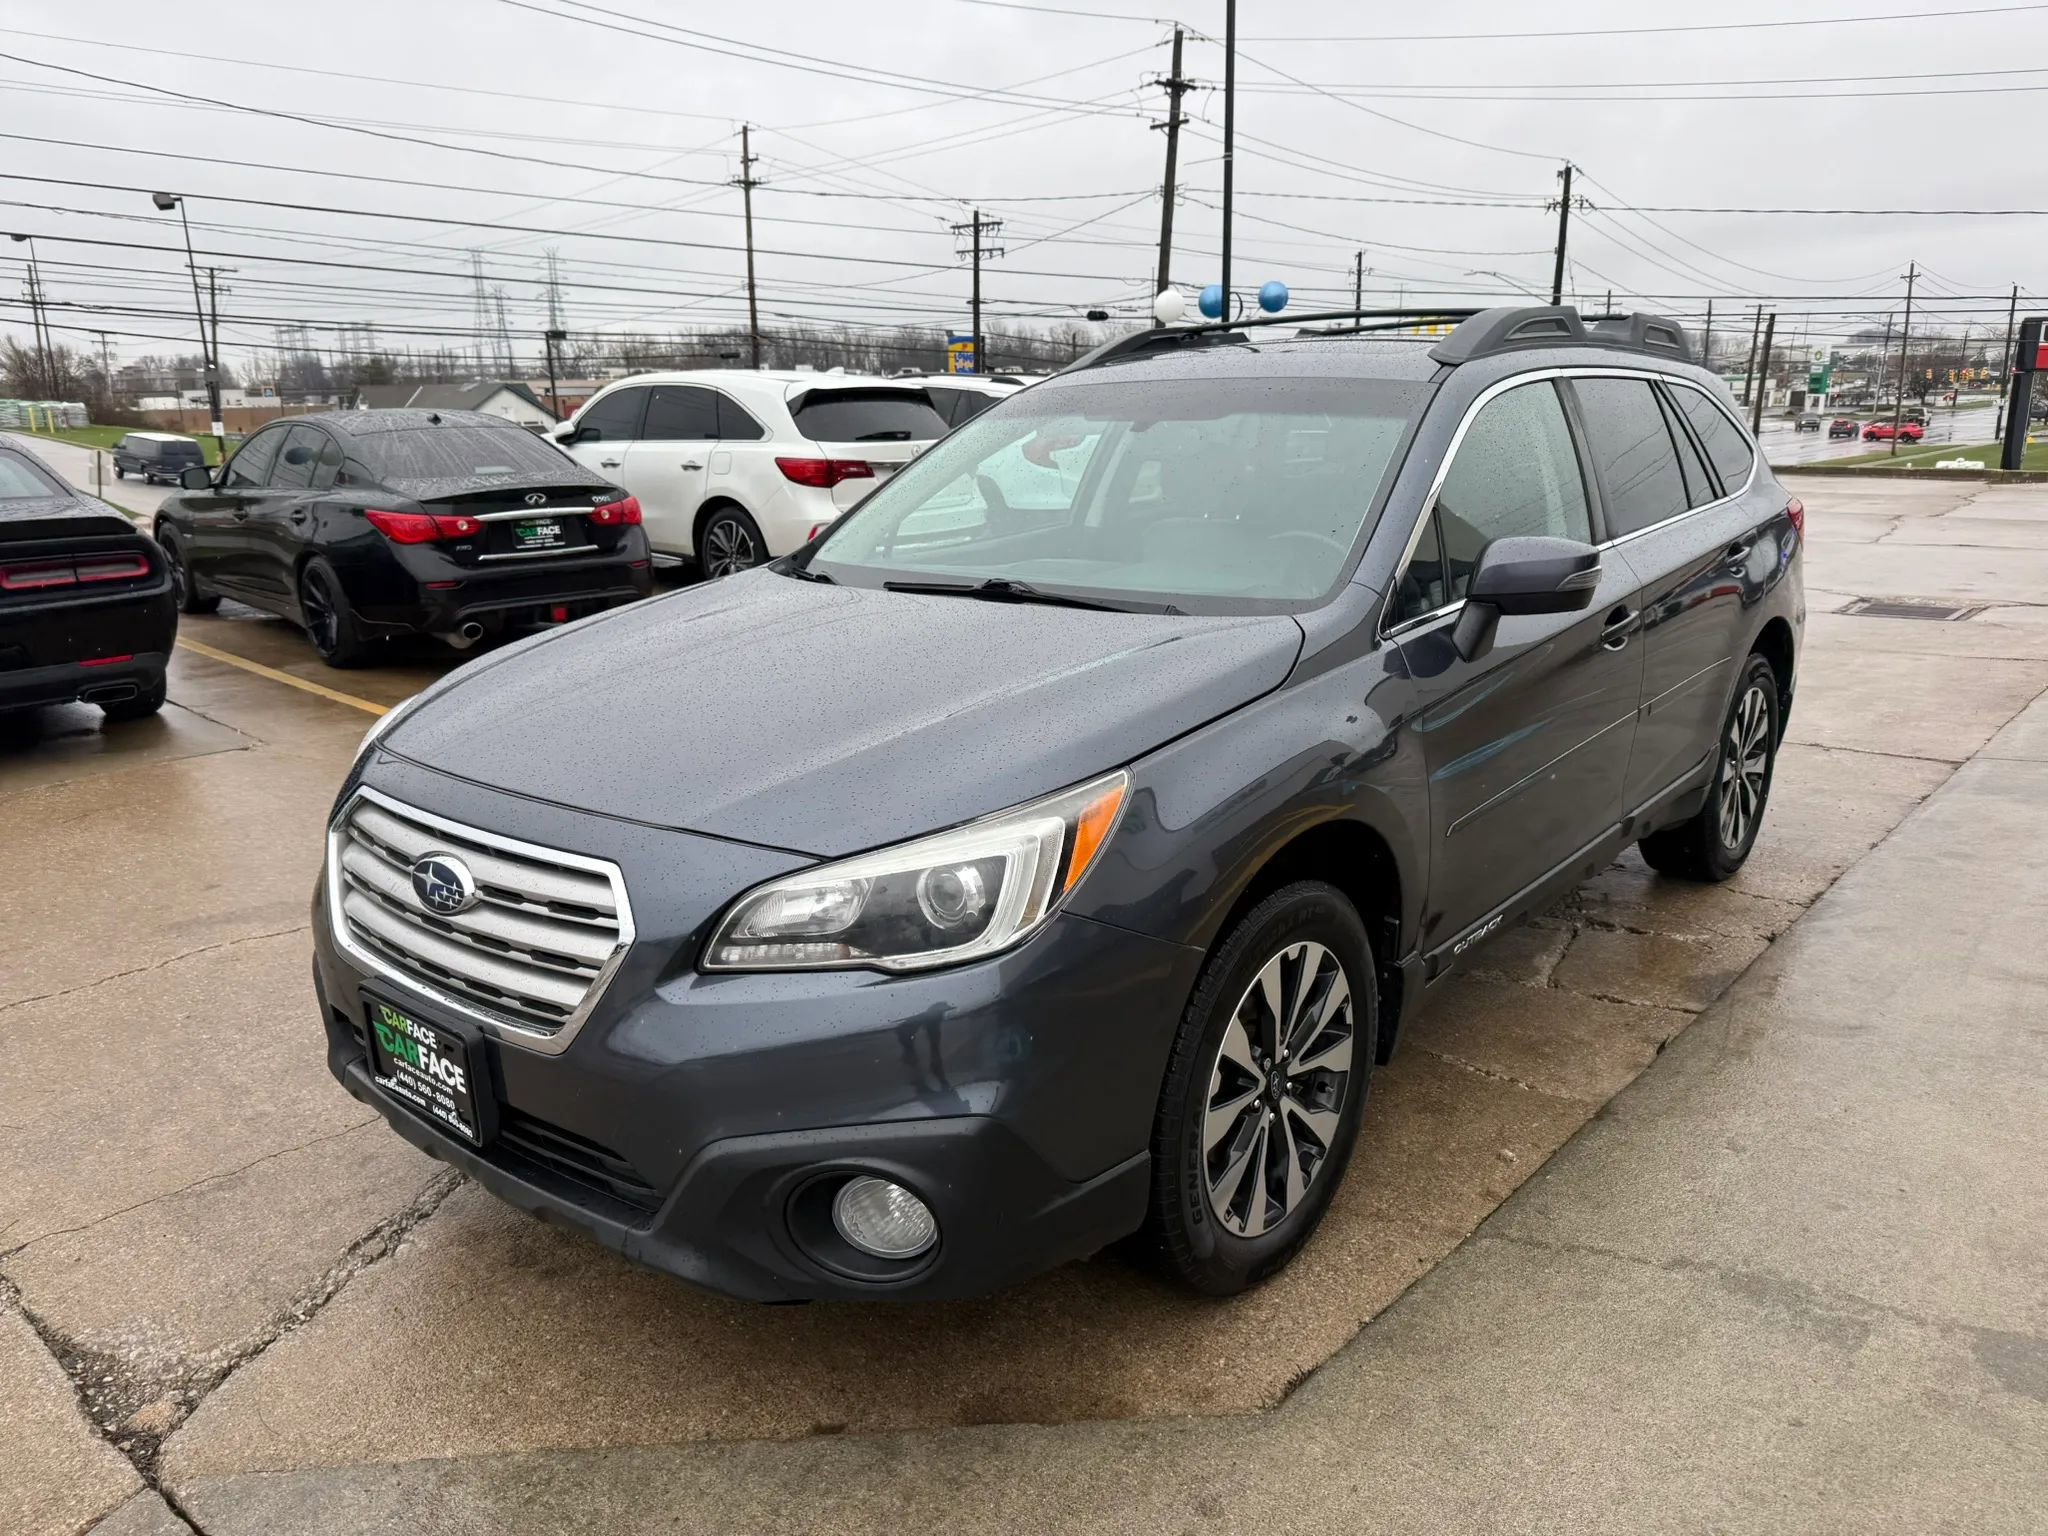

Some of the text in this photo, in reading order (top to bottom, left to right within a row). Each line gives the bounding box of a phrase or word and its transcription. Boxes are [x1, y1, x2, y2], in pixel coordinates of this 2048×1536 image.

[380, 1004, 438, 1049] CARFACE
[372, 1020, 467, 1094] CARFACE
[393, 1057, 453, 1095] carfaceauto.com
[396, 1069, 416, 1090] (440)
